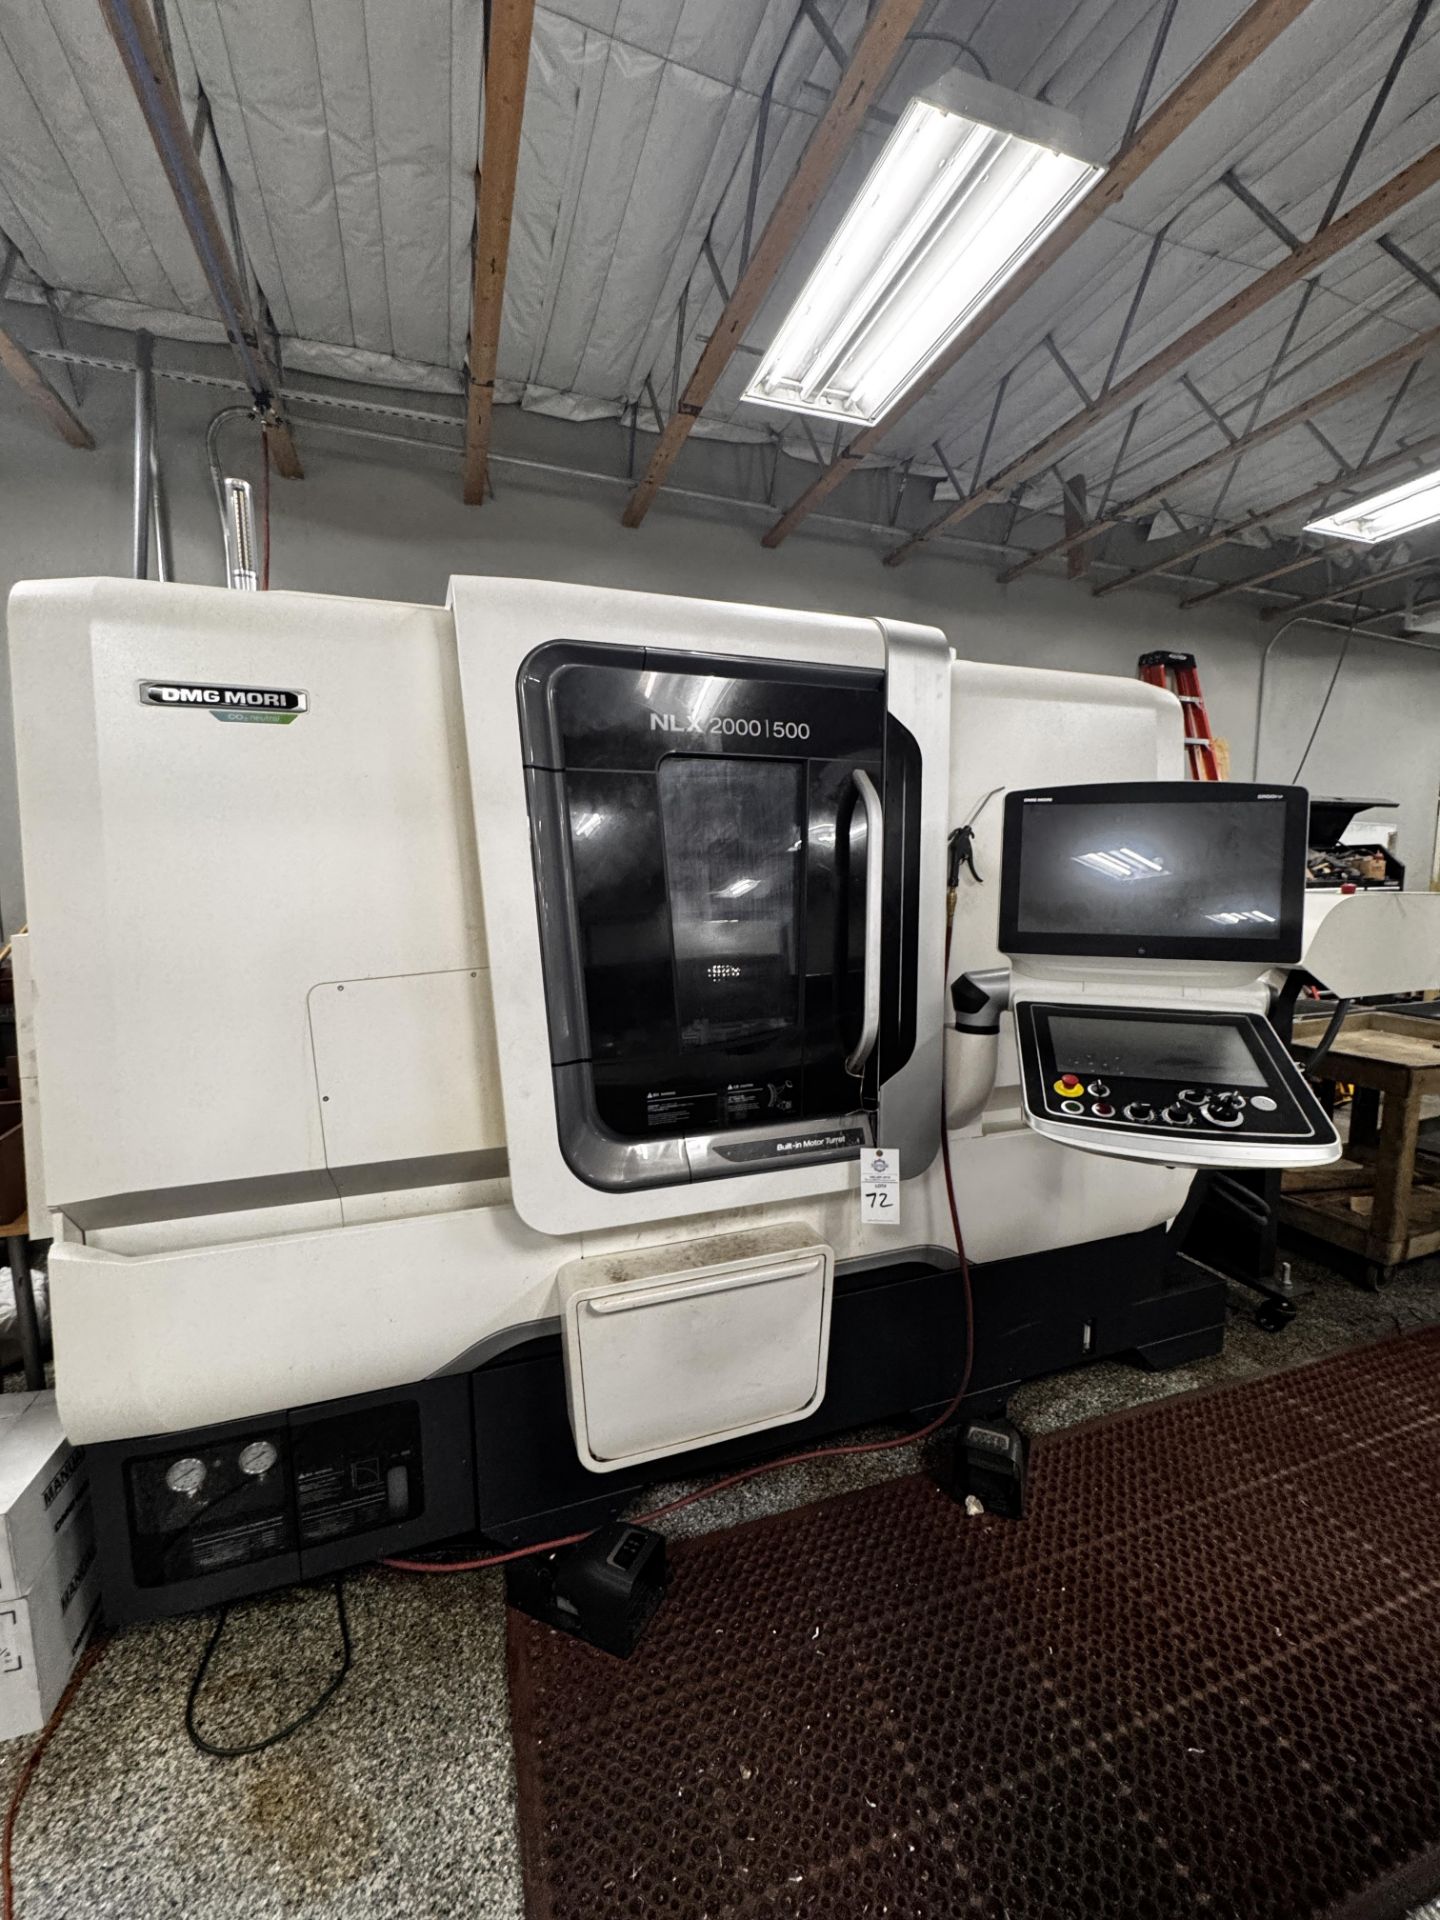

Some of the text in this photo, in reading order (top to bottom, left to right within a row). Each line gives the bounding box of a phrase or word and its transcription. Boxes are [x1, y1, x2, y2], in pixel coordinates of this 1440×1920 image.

[161, 687, 287, 707] DMG MORI
[650, 713, 704, 733] NLX
[776, 1141, 802, 1151] Built-in
[803, 1139, 824, 1149] Motor
[865, 1192, 894, 1209] 72
